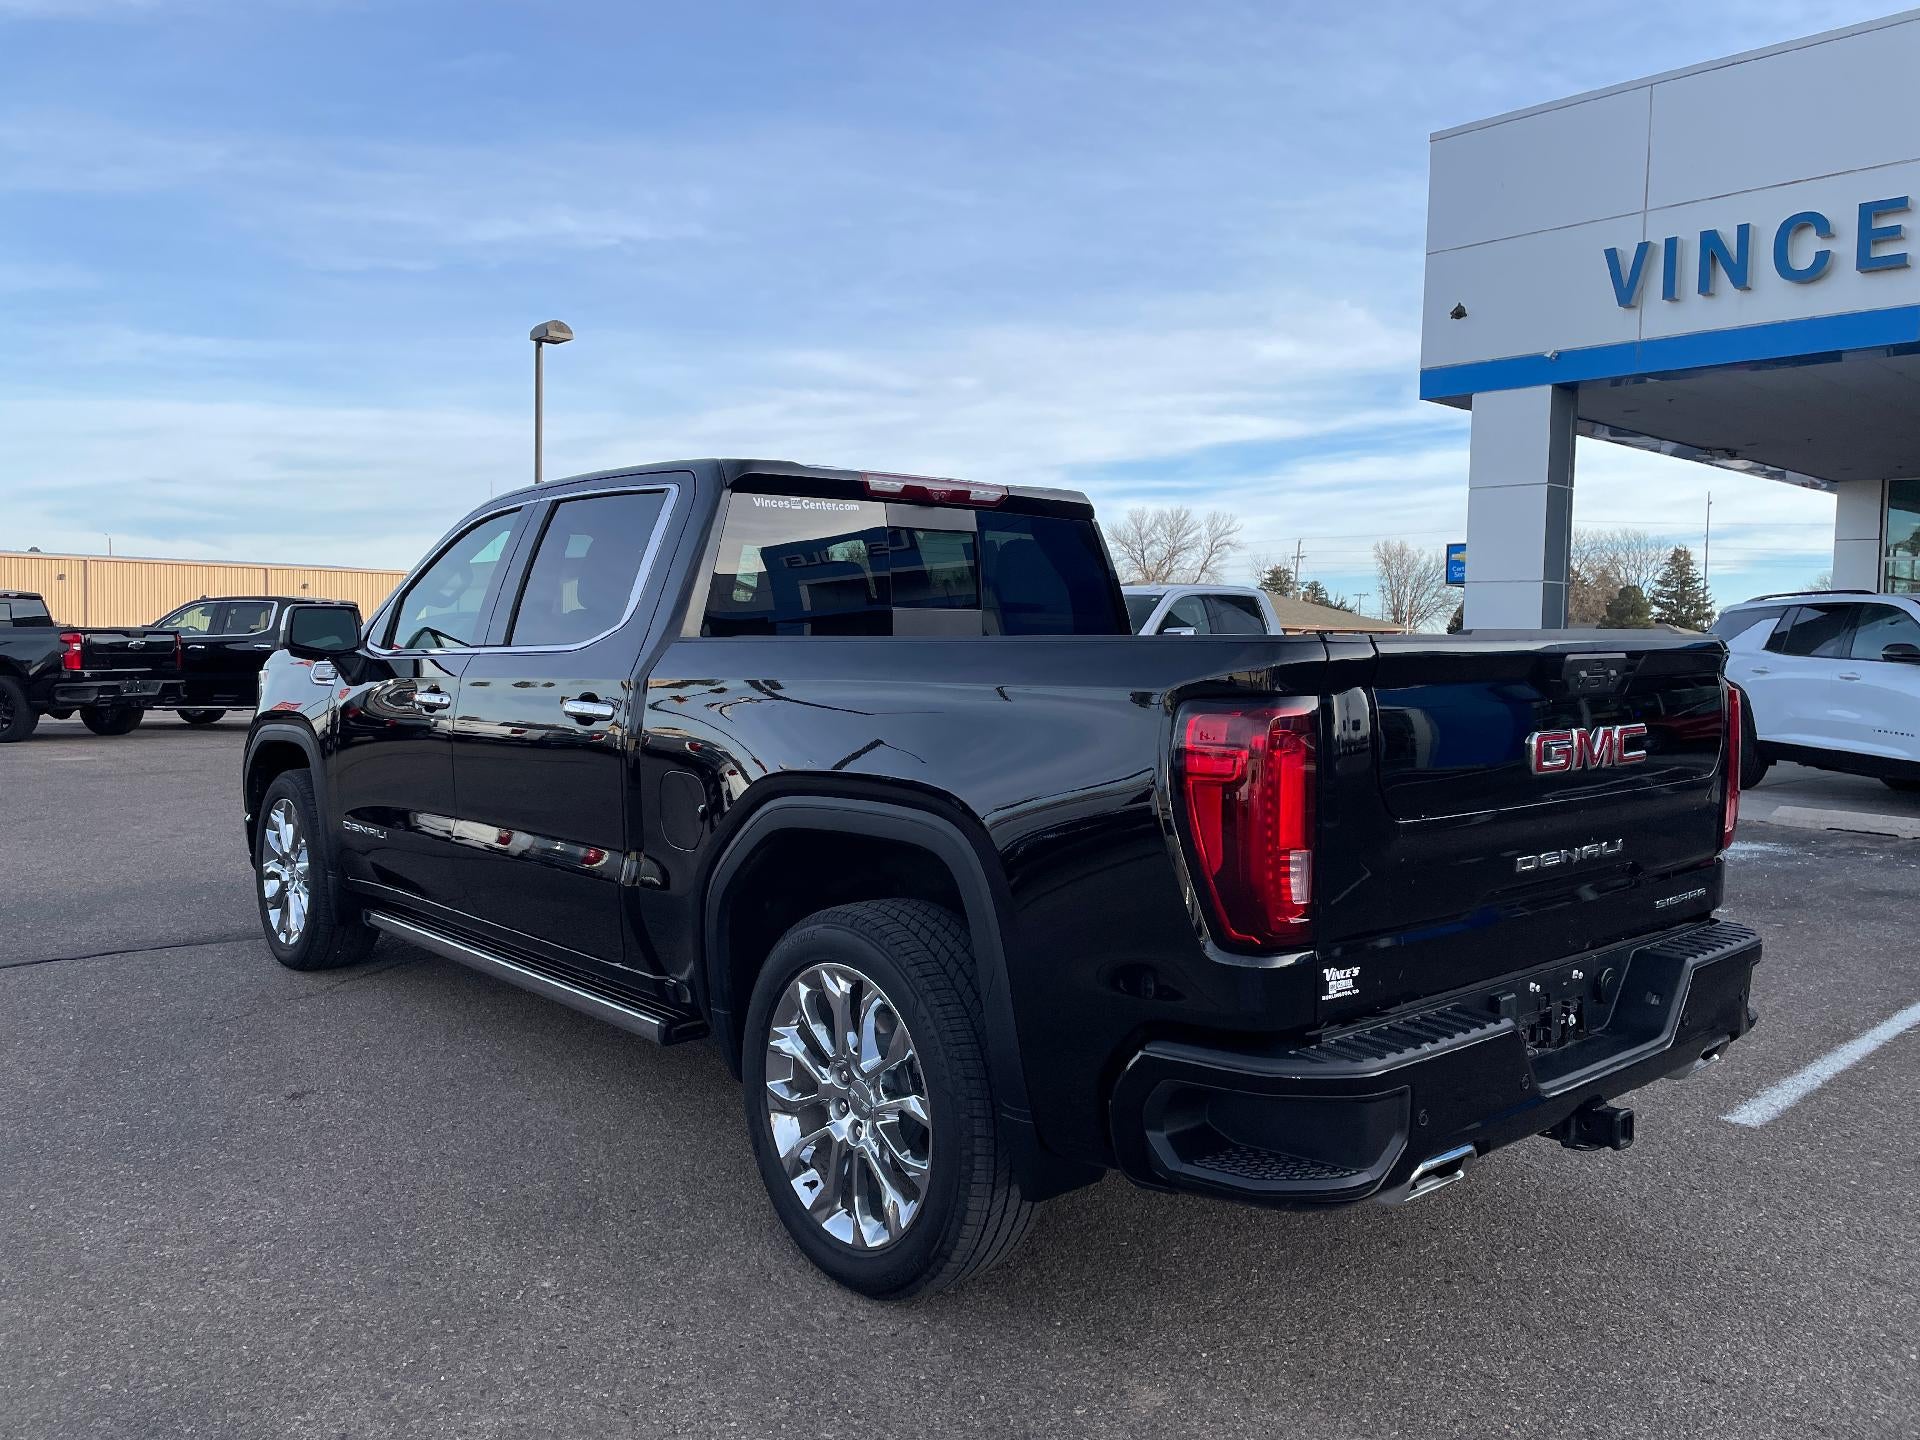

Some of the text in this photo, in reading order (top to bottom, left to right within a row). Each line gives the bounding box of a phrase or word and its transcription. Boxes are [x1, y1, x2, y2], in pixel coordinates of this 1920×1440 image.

[1603, 195, 1912, 309] VINCE
[1525, 722, 1648, 775] GMC
[342, 820, 389, 840] DENALI
[1515, 838, 1624, 872] DENALI
[1655, 887, 1707, 909] SIERRA
